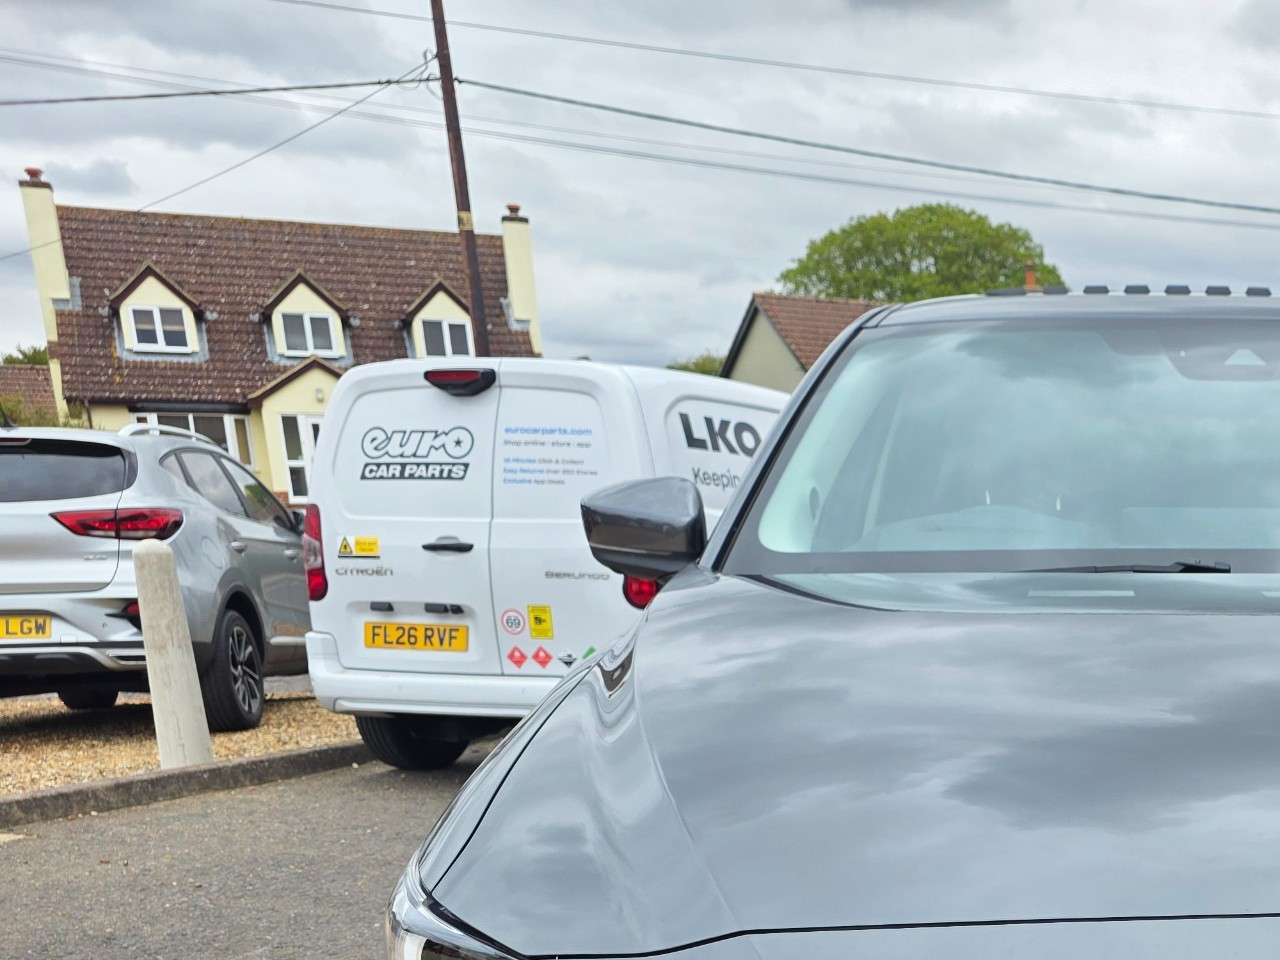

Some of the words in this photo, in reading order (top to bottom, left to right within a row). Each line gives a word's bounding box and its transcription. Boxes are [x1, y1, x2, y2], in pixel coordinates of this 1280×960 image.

[361, 426, 474, 459] euro
[364, 464, 401, 478] CAR
[404, 464, 466, 479] PARTS
[6, 618, 47, 635] LGW
[372, 624, 418, 646] FL26
[424, 627, 460, 647] RVF
